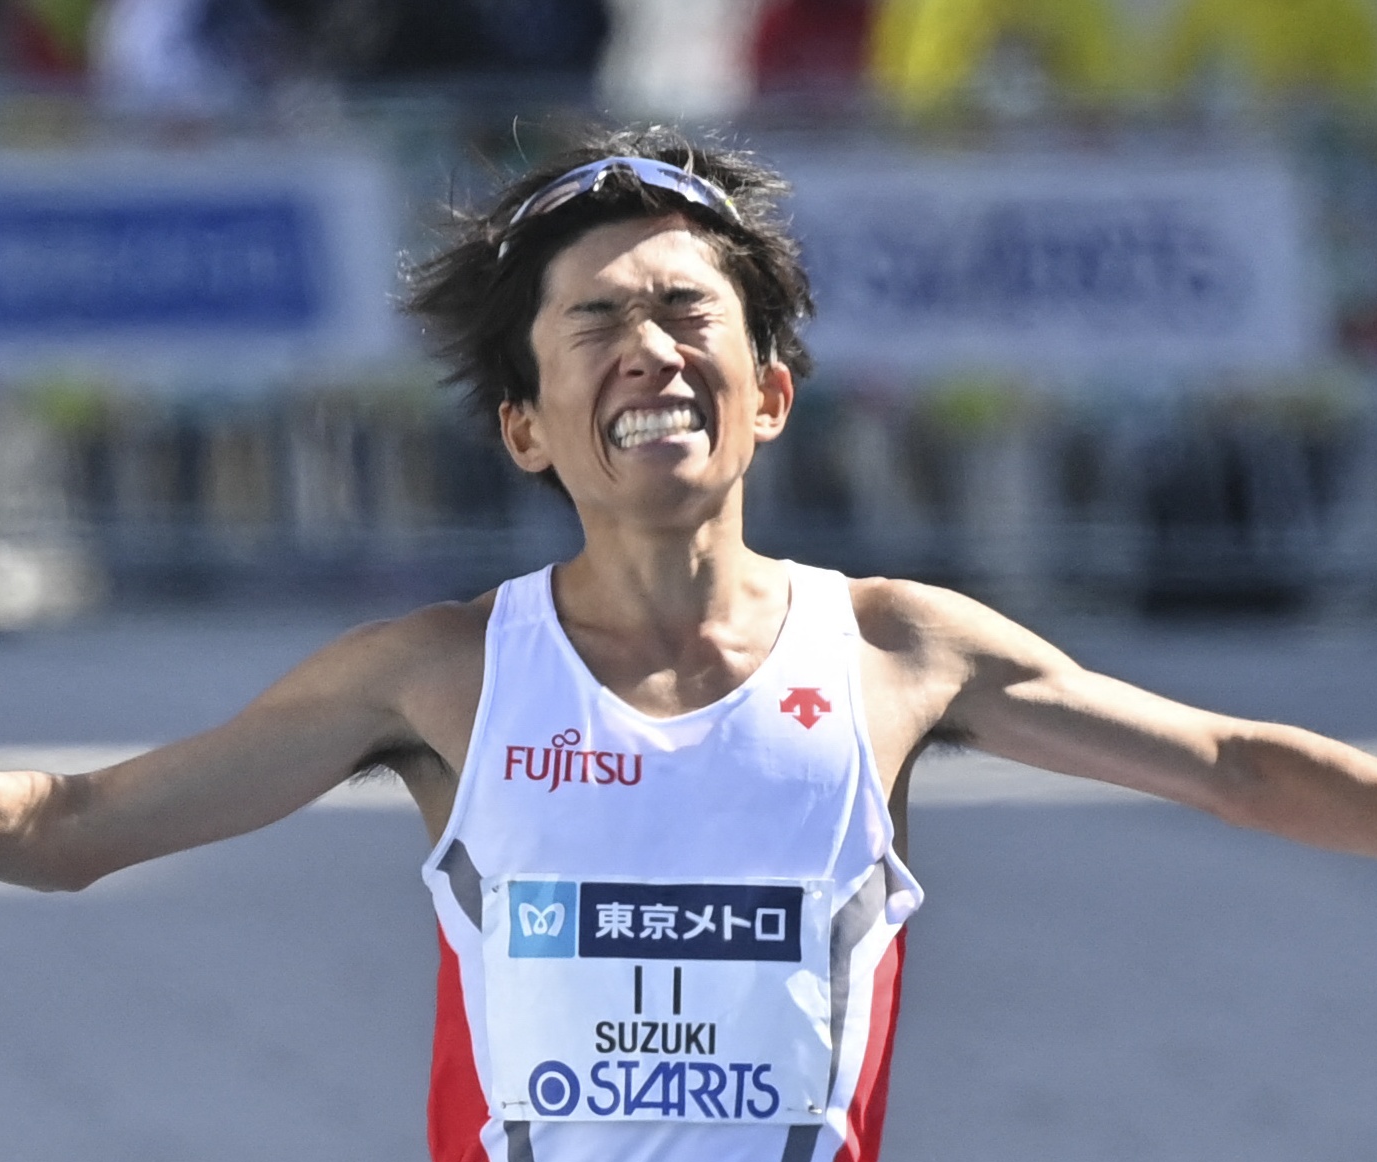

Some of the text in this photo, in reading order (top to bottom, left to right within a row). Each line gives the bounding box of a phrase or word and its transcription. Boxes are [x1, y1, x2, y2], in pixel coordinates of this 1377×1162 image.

[503, 728, 643, 793] FUJITSU
[594, 902, 787, 942] 東京メトロ
[634, 965, 682, 1016] 11
[594, 1021, 717, 1055] SUZUKI
